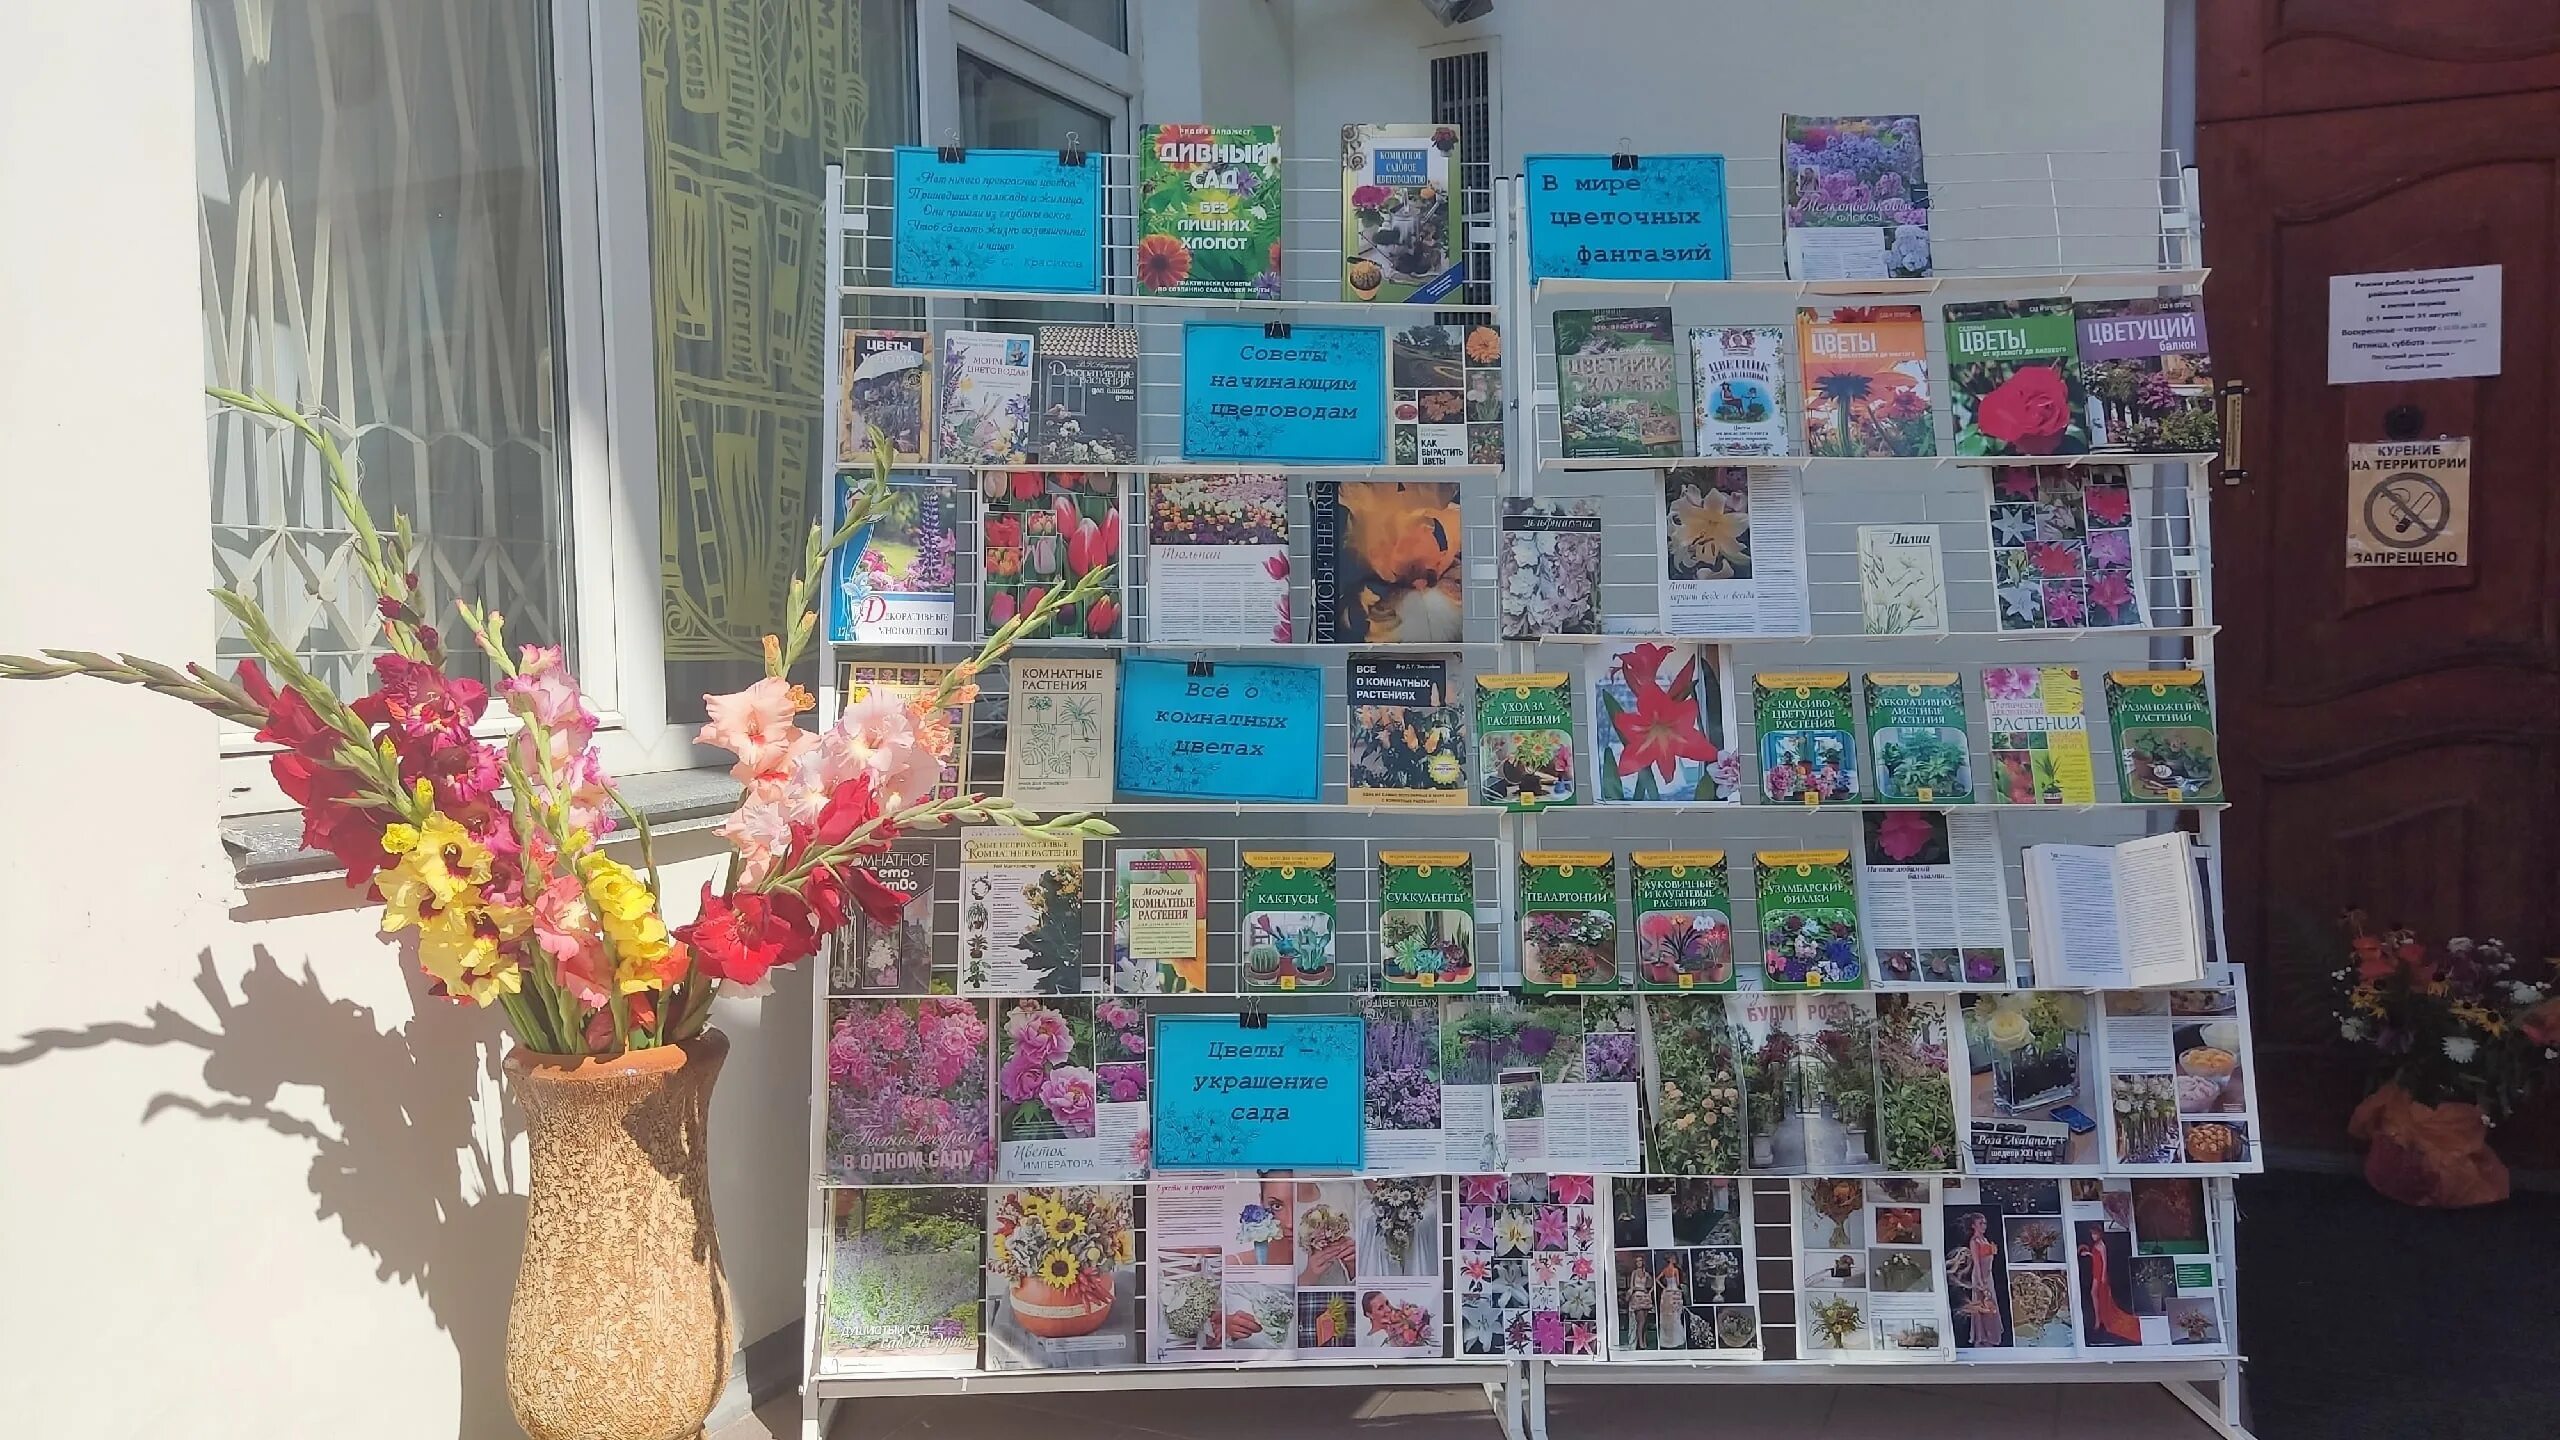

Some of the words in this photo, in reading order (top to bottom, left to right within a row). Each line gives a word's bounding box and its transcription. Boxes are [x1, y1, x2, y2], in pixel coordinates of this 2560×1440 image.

[1159, 142, 1269, 165] ДИВНЫЙ
[1190, 169, 1240, 188] САД
[1541, 175, 1559, 191] В
[1575, 177, 1642, 196] мире
[1200, 201, 1229, 215] БЕЗ
[1550, 210, 1701, 227] цветочных
[1177, 219, 1252, 232] ЛИШНИХ
[1180, 236, 1248, 250] ХЛОПОТ
[1576, 246, 1712, 266] фантазий
[731, 245, 756, 373] ТОЛСТОЙ
[2087, 312, 2196, 345] ЦВЕТУЩИЙ
[866, 340, 912, 351] ЦВЕТЫ
[1811, 331, 1876, 355] ЦВЕТЫ
[1960, 328, 2027, 354] ЦВЕТЫ
[2159, 340, 2197, 351] балкон
[2391, 339, 2425, 350] суббота
[1239, 345, 1328, 362] Советы
[1209, 374, 1357, 392] начинающим
[1210, 403, 1358, 419] цветоводам
[1421, 439, 1438, 447] КАК
[1421, 448, 1464, 456] ВЫРАСТИТЬ
[2377, 445, 2441, 456] КУРЕНИЕ
[1422, 457, 1446, 465] ЦВЕТЫ
[2351, 460, 2370, 470] НА
[2375, 458, 2467, 470] ТЕРРИТОРИИ
[1889, 531, 1931, 545] Лилии
[2353, 551, 2457, 565] ЗАПРЕЩЕНО
[1316, 571, 1335, 643] ИРИСЫ
[1022, 668, 1103, 679] КОМНАТНЫЕ
[1356, 665, 1377, 673] ВСЕ
[1022, 680, 1088, 690] РАСТЕНИЯ
[1356, 677, 1364, 686] О
[1366, 678, 1431, 687] КОМНАТНЫХ
[1185, 682, 1229, 698] Всё
[1244, 686, 1259, 698] о
[1356, 690, 1416, 700] РАСТЕНИЯХ
[1501, 702, 1530, 713] УХОД
[1531, 702, 1545, 711] ЗА
[1778, 699, 1831, 709] КРАСИВО
[1877, 698, 1952, 707] ДЕКОРАТИВНО
[2120, 702, 2202, 712] РАЗМНОЖЕНИЕ
[1772, 709, 1836, 720] ЦВЕТУЩИЕ
[1891, 707, 1943, 716] ЛИСТНЫЕ
[1154, 710, 1288, 729] комнатных
[1487, 715, 1561, 726] РАСТЕНИЯМИ
[1891, 715, 1945, 724] РАСТЕНИЯ
[1992, 716, 2082, 730] РАСТЕНИЯ
[2134, 713, 2193, 722] РАСТЕНИЙ
[1775, 719, 1836, 729] РАСТЕНИЯ
[1173, 740, 1265, 756] цветах
[1031, 849, 1080, 857] РАСТЕНИЯ
[860, 853, 931, 866] МНАТНОЕ
[1643, 880, 1714, 890] ЛУКОВИЧНЫЕ
[1768, 883, 1844, 895] УЗАМБАРСКИЕ
[1143, 887, 1183, 897] Модные
[1386, 892, 1465, 903] СУККУЛЕНТЫ
[1527, 891, 1607, 903] ПЕЛАРГОНИИ
[1645, 889, 1654, 898] И
[1655, 889, 1714, 899] КЛУБНЕВЫЕ
[1132, 898, 1195, 909] КОМНАТНЫЕ
[1258, 894, 1319, 905] КАКТУСЫ
[1653, 898, 1707, 908] РАСТЕНИЯ
[1783, 894, 1830, 904] ФИАЛКИ
[1138, 909, 1188, 920] РАСТЕНИЯ
[1747, 1006, 1795, 1021] БУДУТ
[1207, 1042, 1284, 1059] Цветы
[1193, 1076, 1329, 1094] украшение
[1231, 1107, 1290, 1121] сада
[1014, 1145, 1067, 1159] Цветок
[843, 1154, 855, 1169] В
[860, 1151, 923, 1173] ОДНОМ
[928, 1149, 975, 1170] САДУ
[1023, 1159, 1094, 1169] ИМПЕРАТОРА
[841, 1325, 905, 1337] ДУШИСТЫЙ
[907, 1325, 930, 1335] САД
